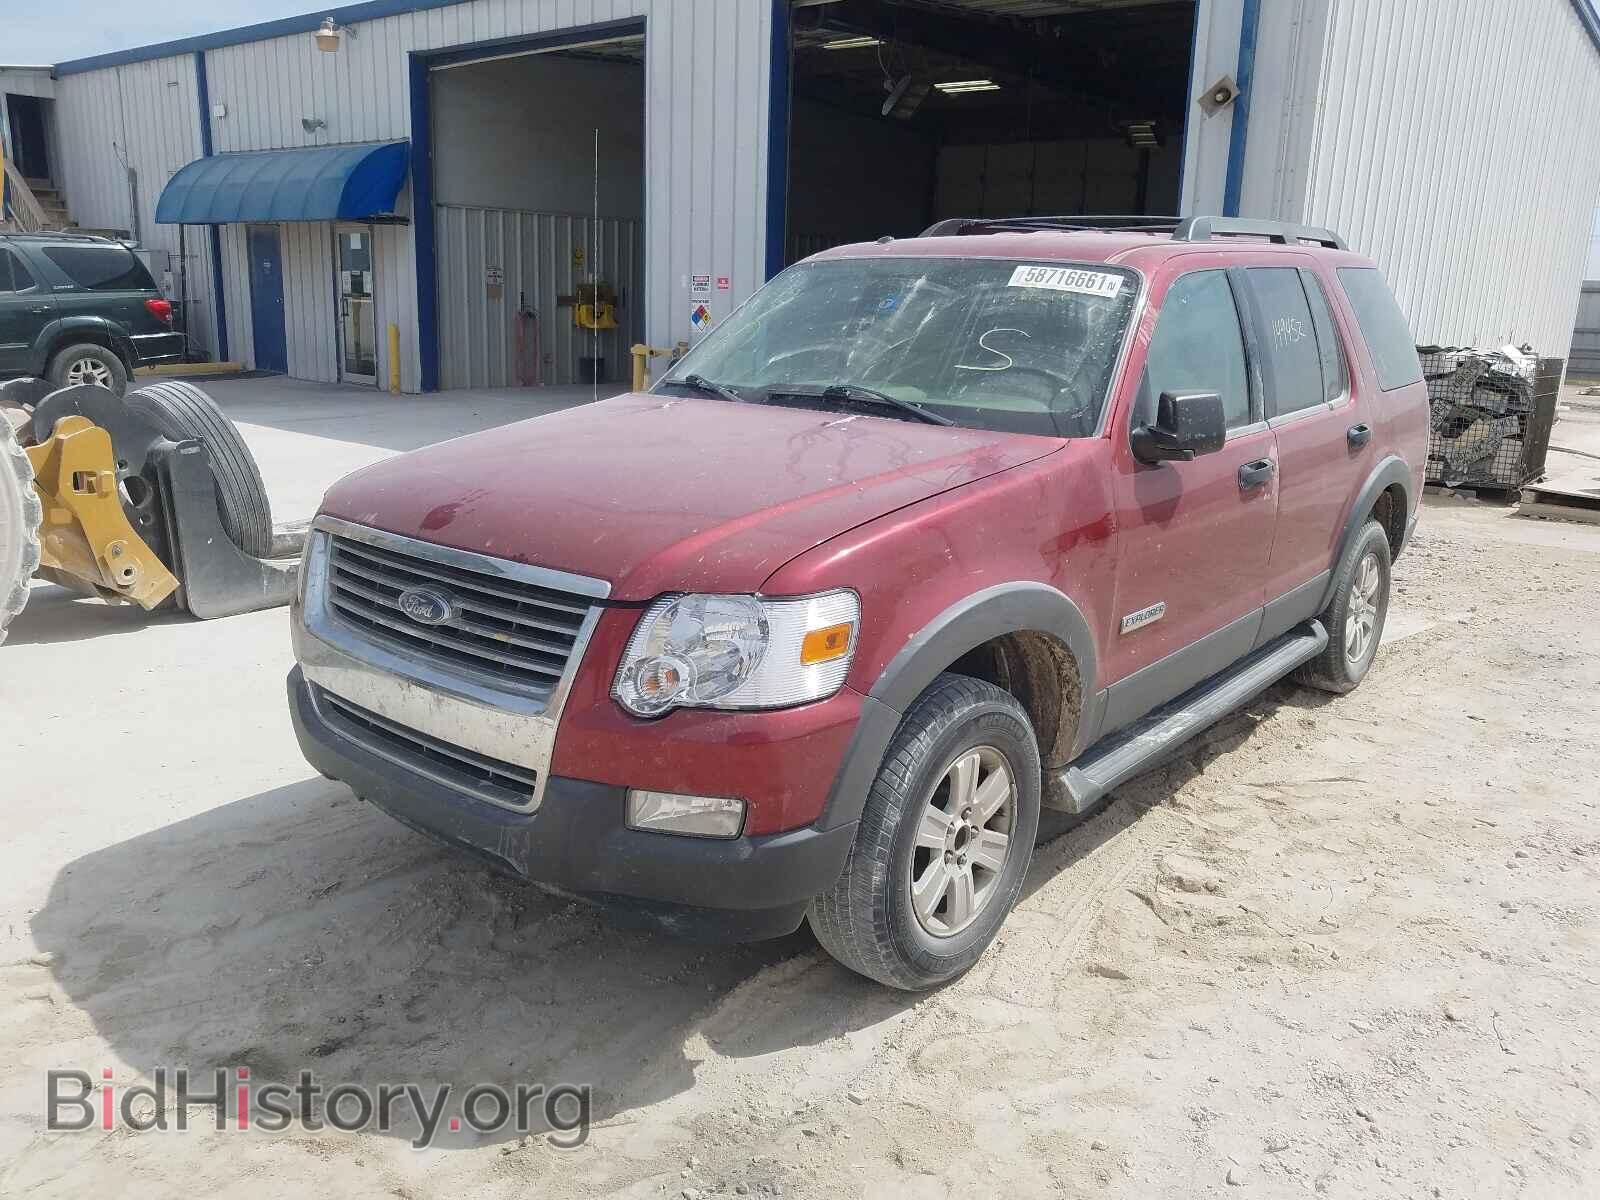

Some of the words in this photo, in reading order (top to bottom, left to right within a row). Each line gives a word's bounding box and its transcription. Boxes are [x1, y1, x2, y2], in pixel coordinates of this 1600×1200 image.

[1025, 267, 1107, 290] 58716661
[953, 328, 1032, 371] S
[406, 594, 433, 618] Ford
[1124, 604, 1165, 627] EXPLORER
